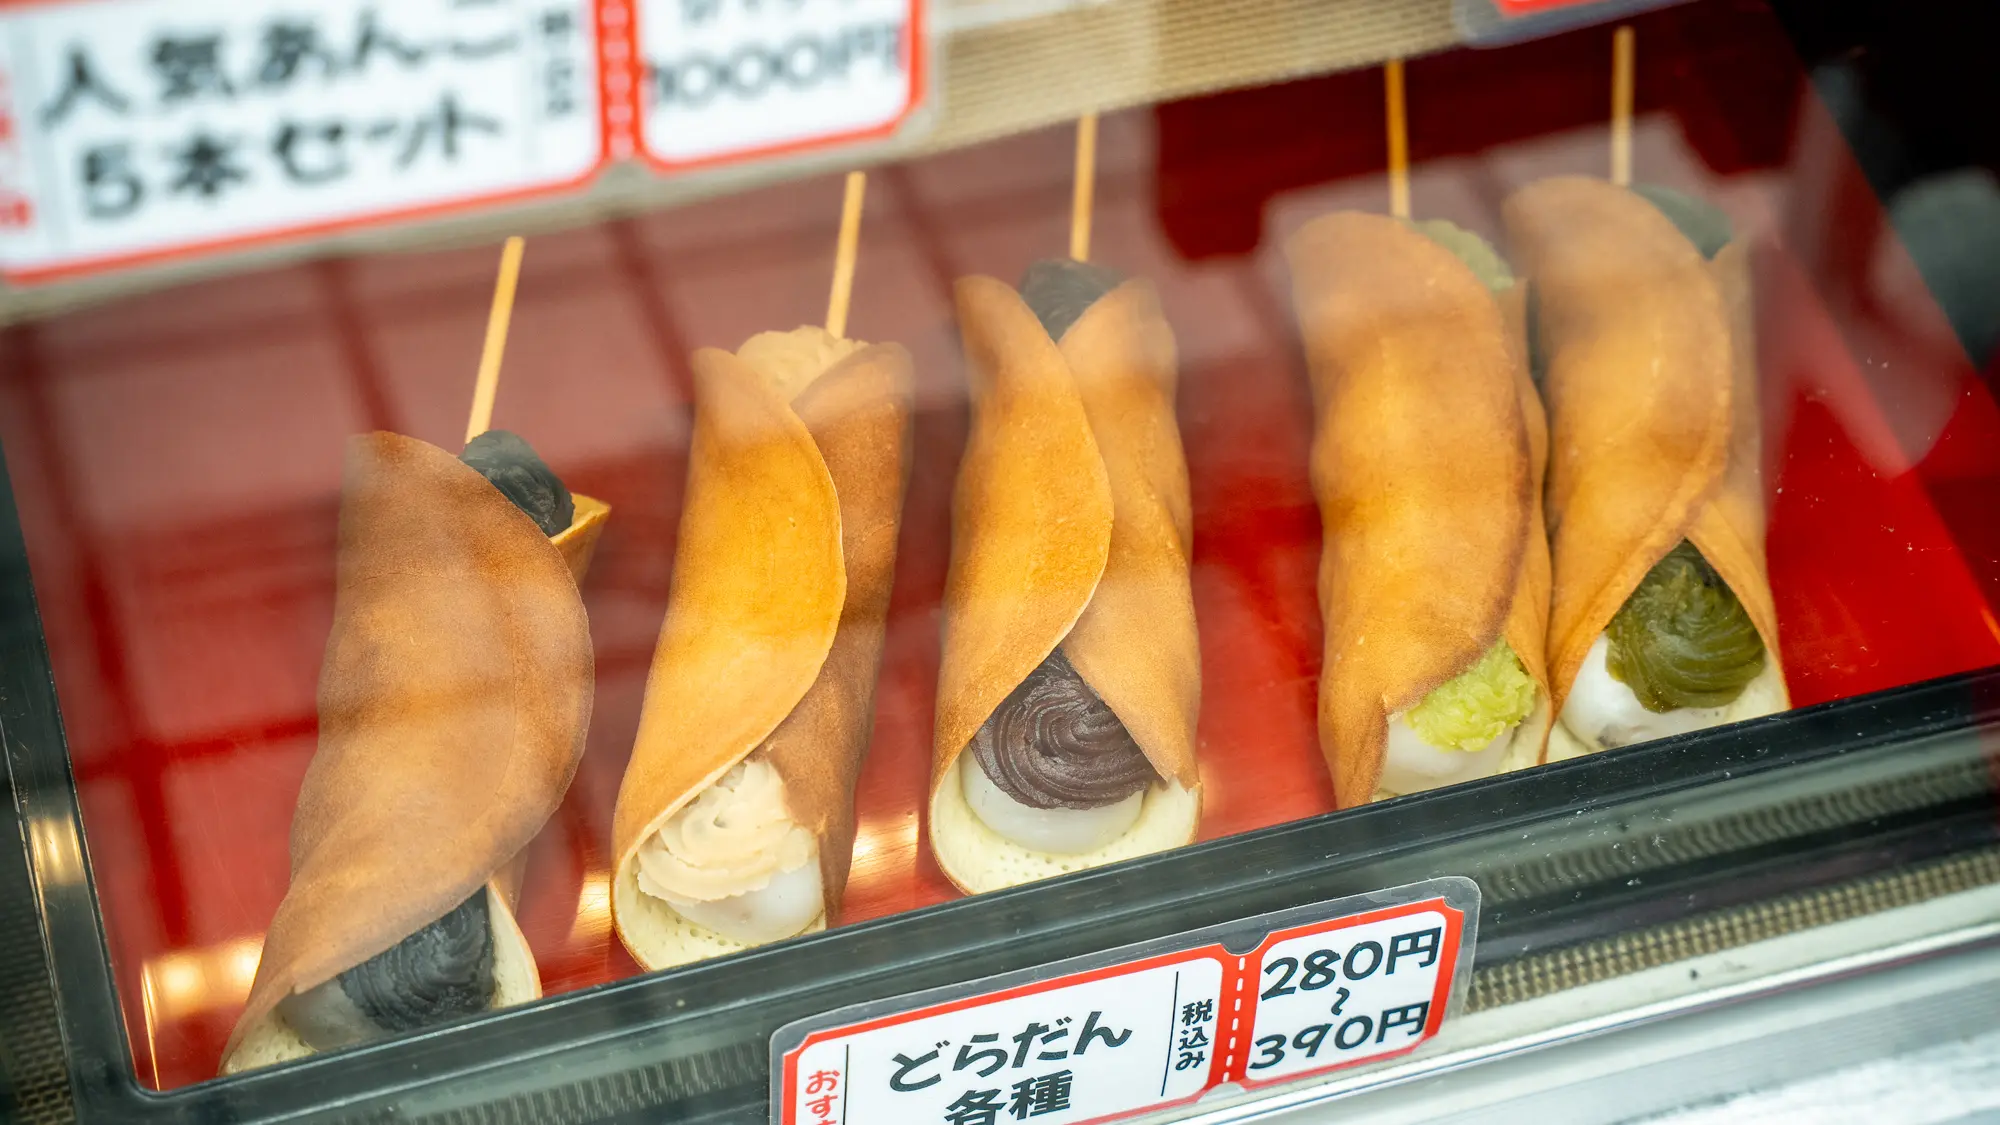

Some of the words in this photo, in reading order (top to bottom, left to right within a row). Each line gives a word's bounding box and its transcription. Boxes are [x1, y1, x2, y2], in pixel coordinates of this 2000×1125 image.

[38, 0, 521, 131] 人気あんこ
[79, 90, 506, 222] 5本セット
[1260, 926, 1442, 1002] 280円
[889, 1011, 1133, 1092] どらだん
[1175, 998, 1213, 1071] 税込み
[1249, 1000, 1431, 1070] 390円
[805, 1069, 840, 1125] おす
[944, 1069, 1074, 1125] 各種
